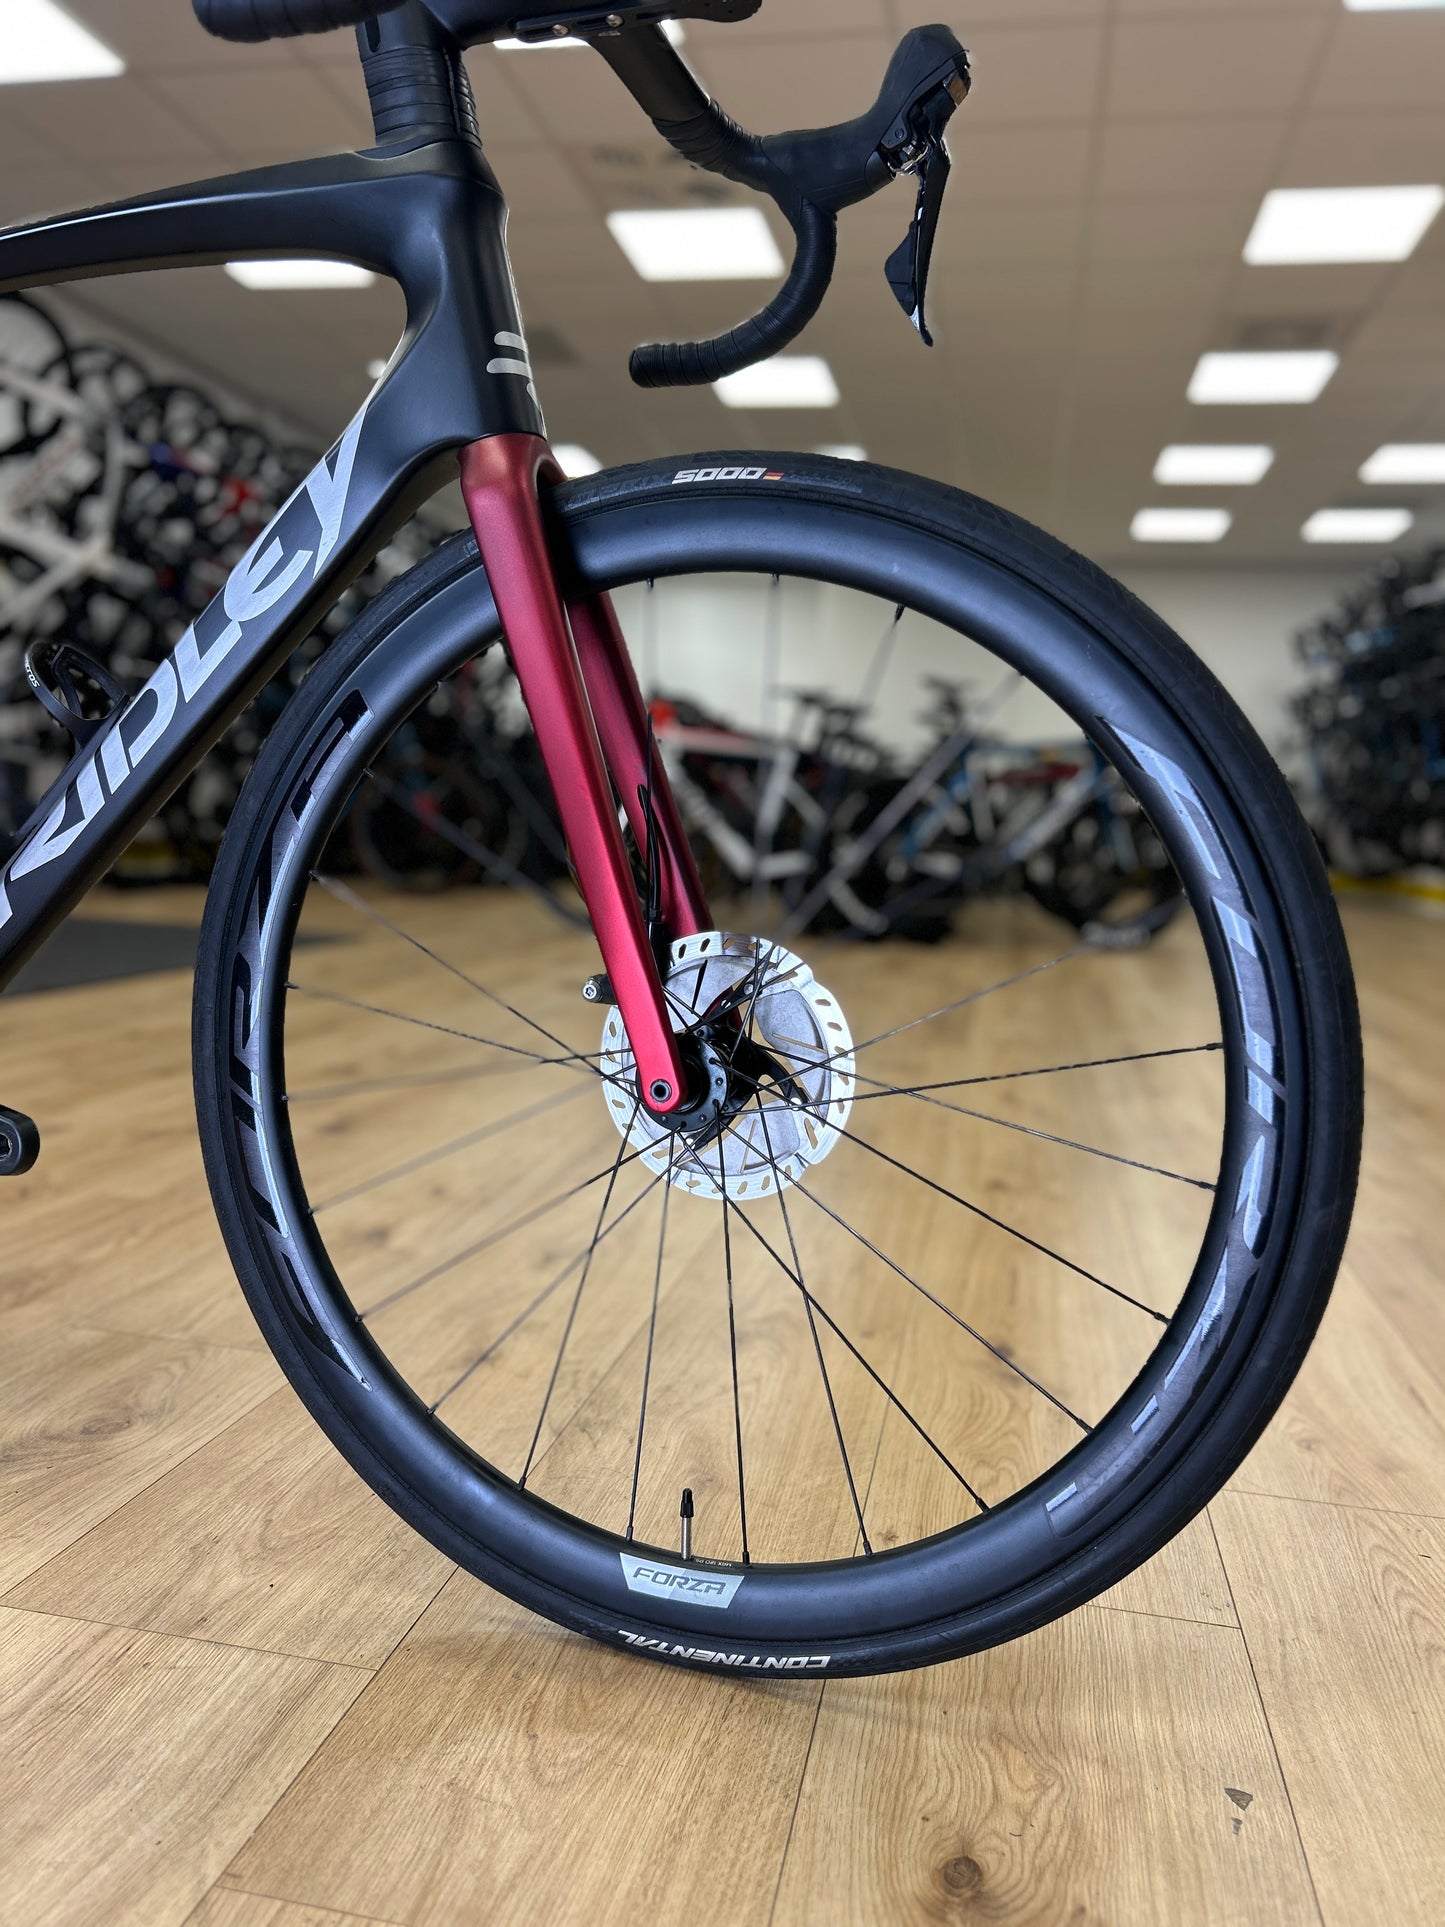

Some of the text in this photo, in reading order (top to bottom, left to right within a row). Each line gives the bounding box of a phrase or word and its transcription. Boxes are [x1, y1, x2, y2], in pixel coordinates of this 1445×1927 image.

[671, 466, 767, 485] 5000
[0, 400, 369, 931] RIDLEY
[632, 1567, 727, 1595] FORZA
[618, 1629, 831, 1669] CONTINENTAL
